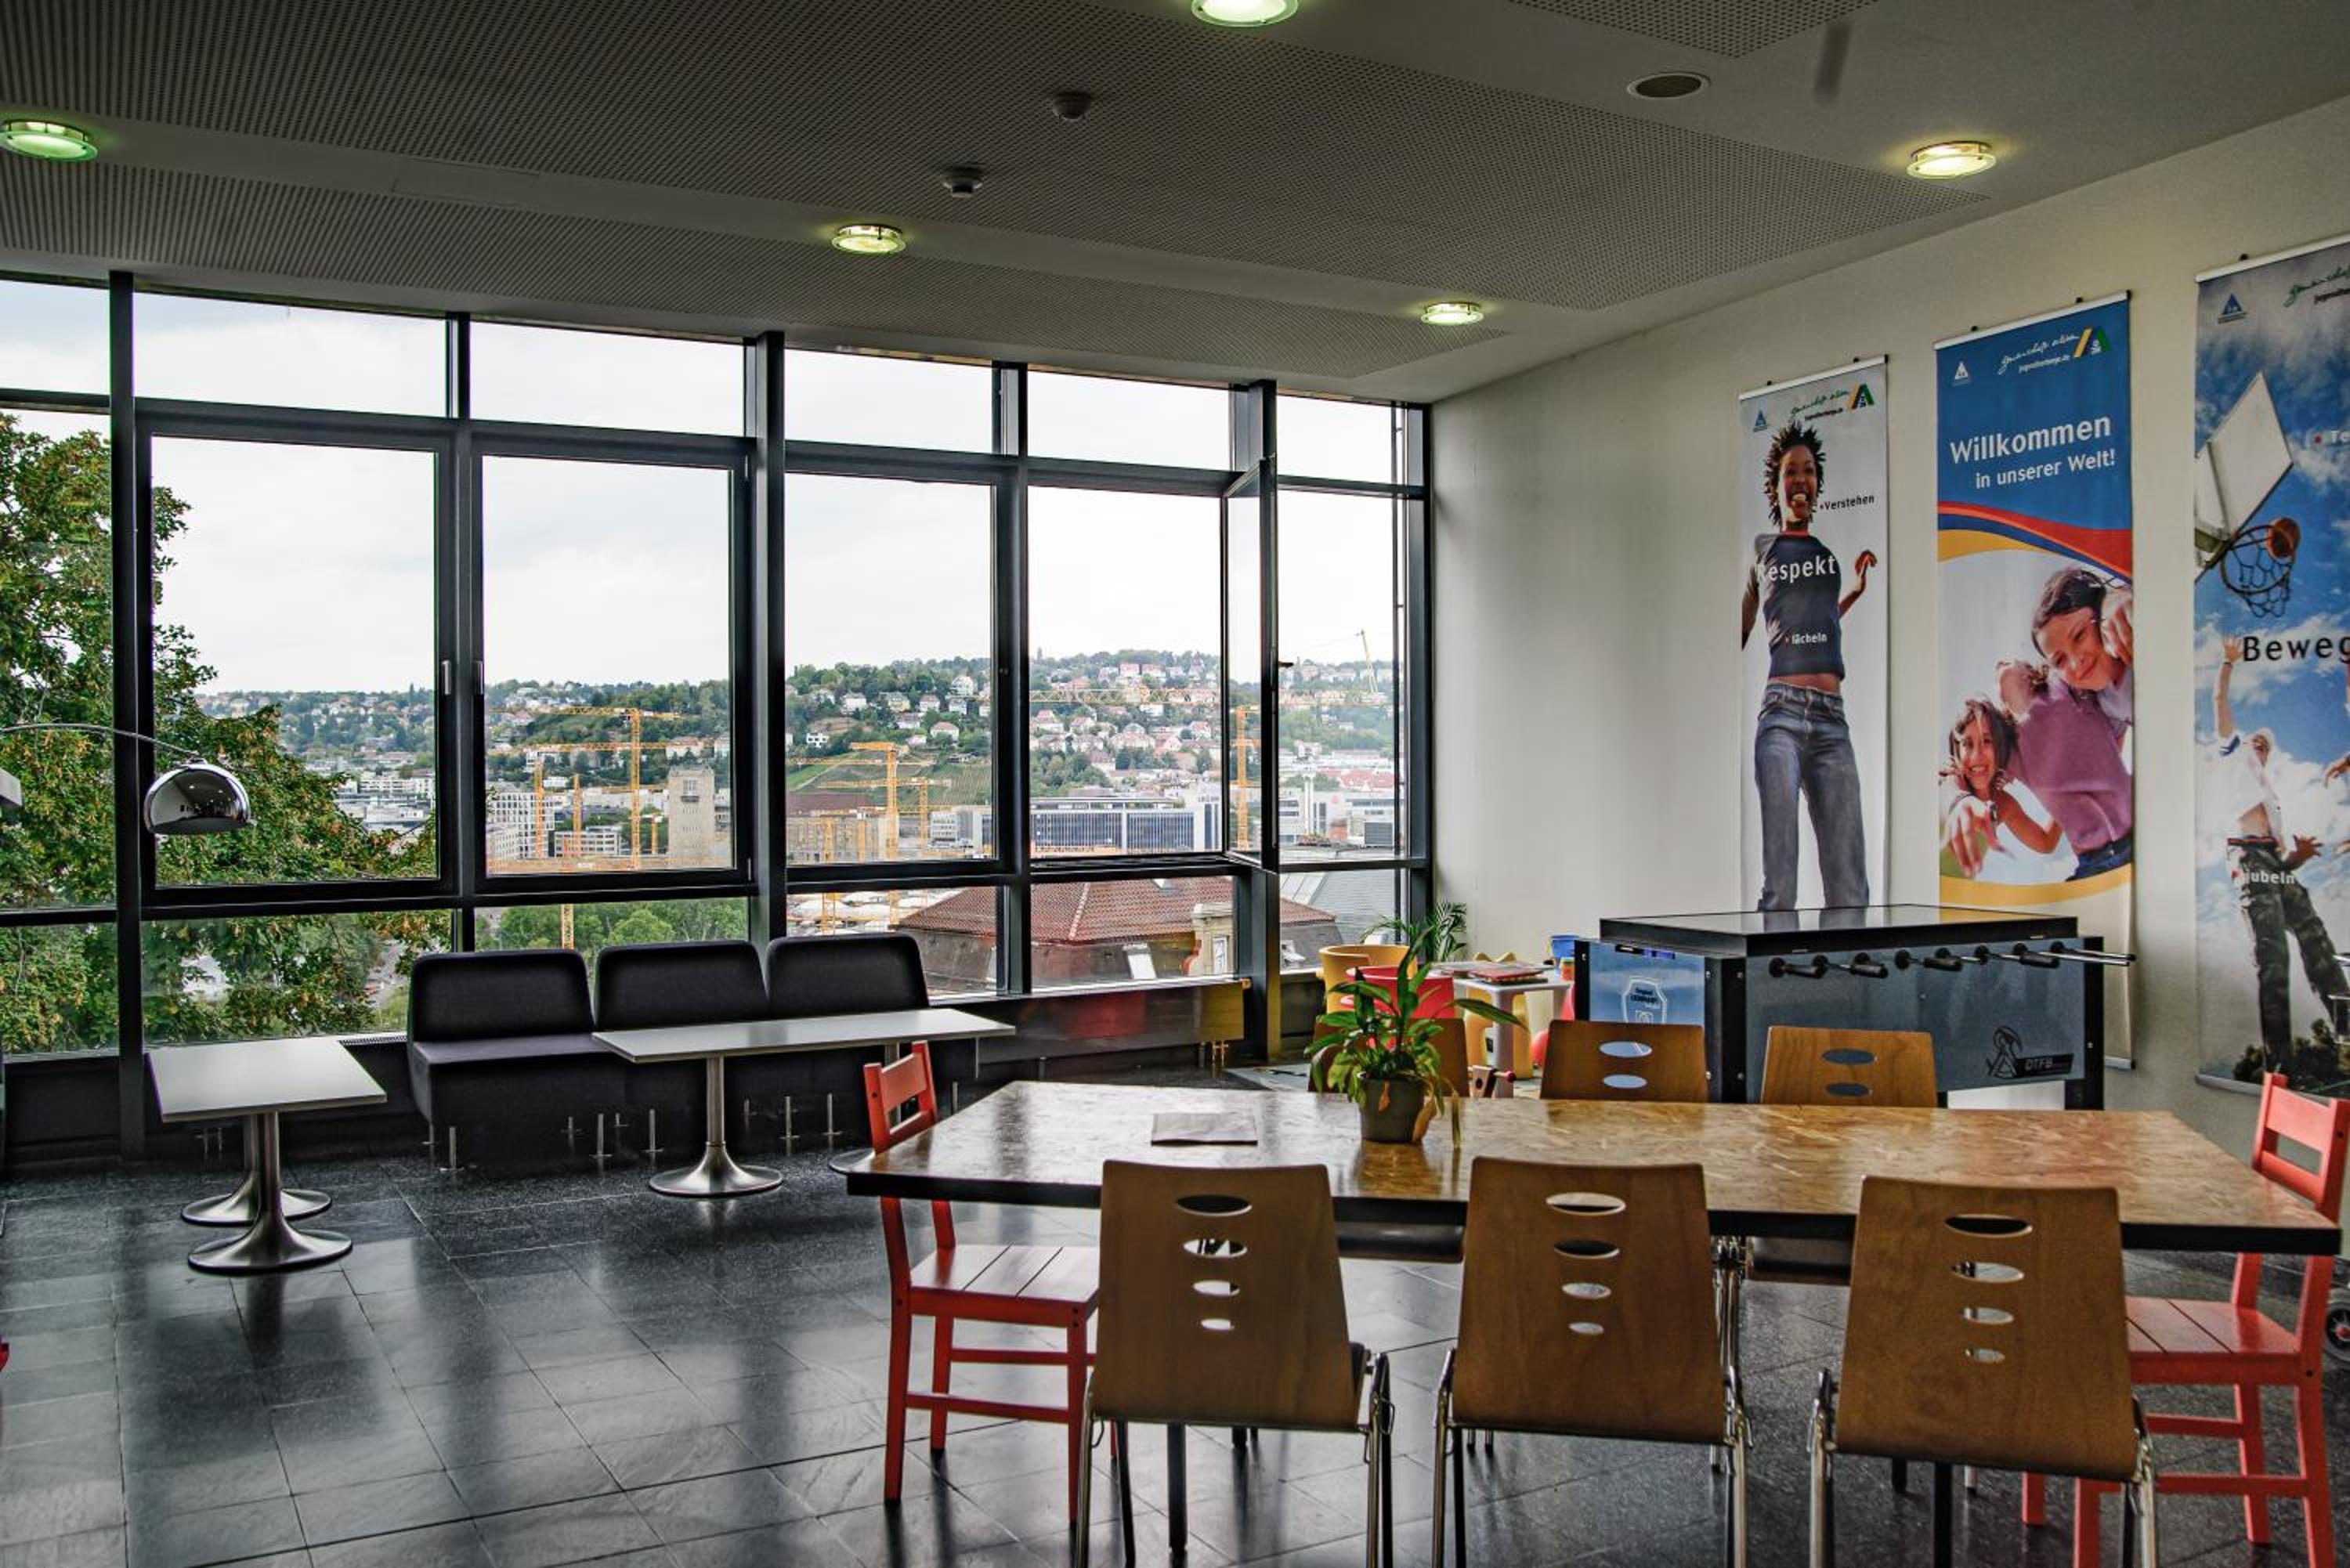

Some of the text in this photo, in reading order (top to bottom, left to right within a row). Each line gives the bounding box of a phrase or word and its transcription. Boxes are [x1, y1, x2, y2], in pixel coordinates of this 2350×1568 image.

[1950, 416, 2111, 464] Willkommen
[1976, 449, 2116, 489] in unserer Welt!
[1824, 494, 1875, 510] Verstehen
